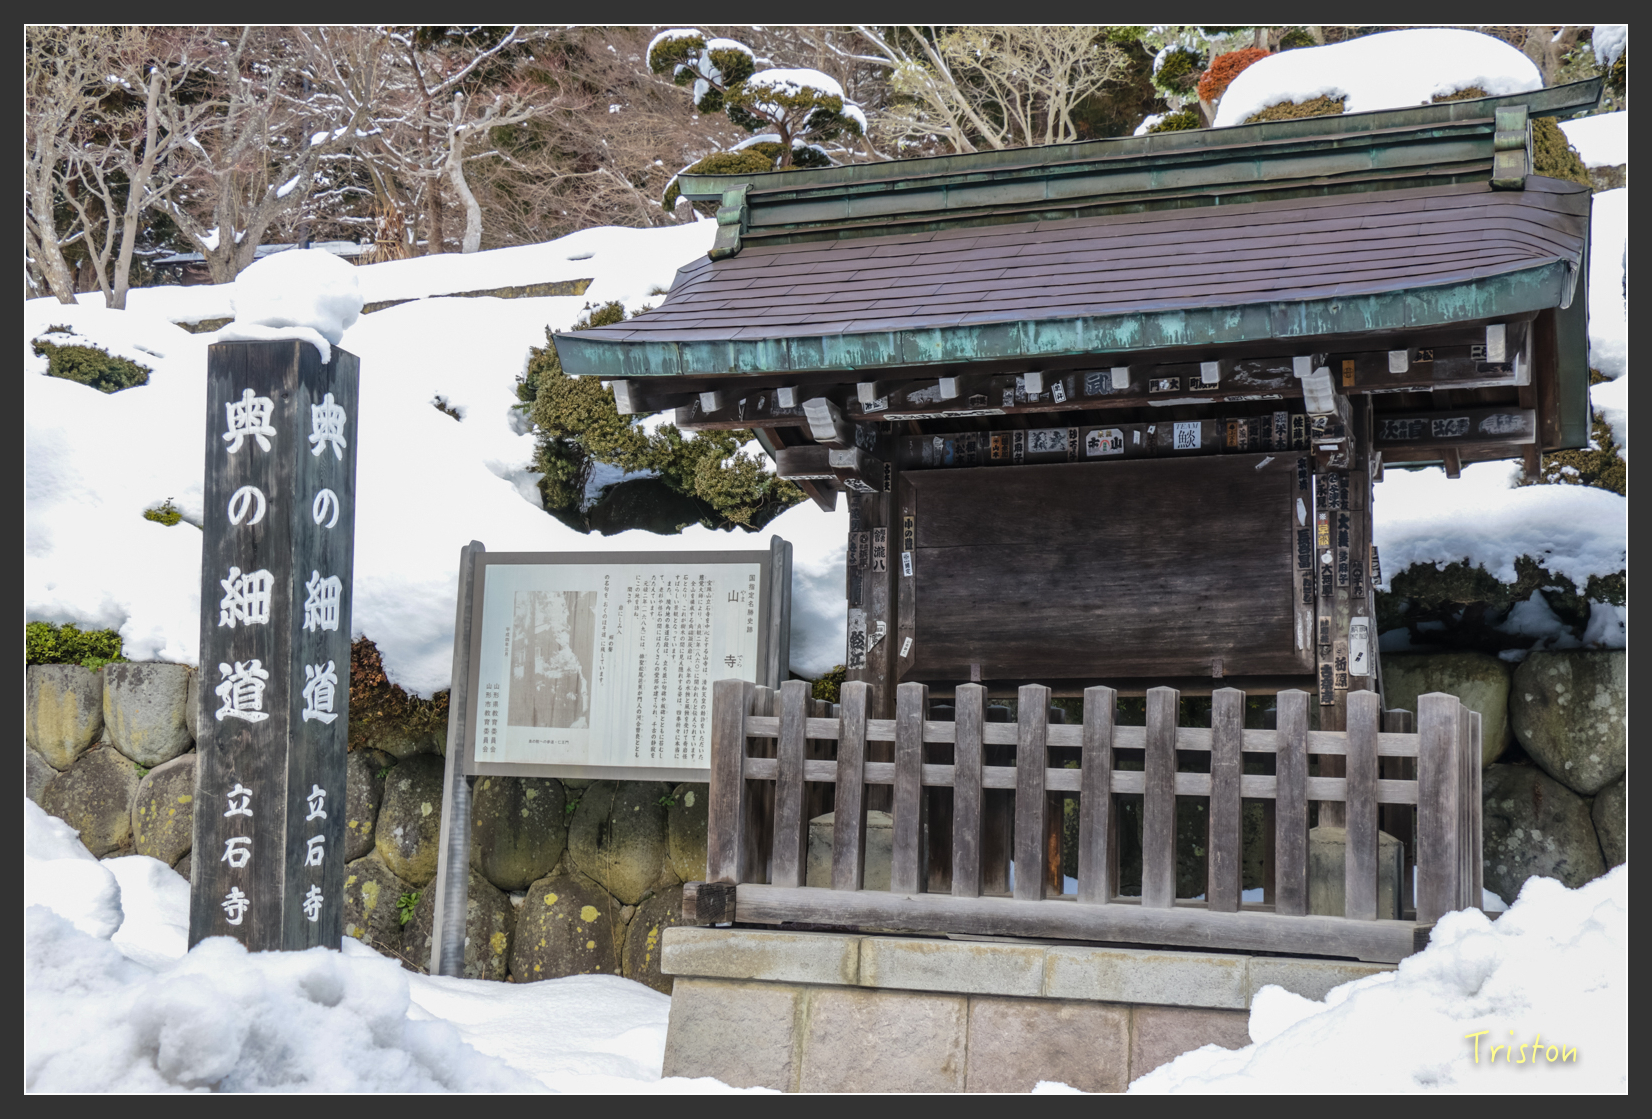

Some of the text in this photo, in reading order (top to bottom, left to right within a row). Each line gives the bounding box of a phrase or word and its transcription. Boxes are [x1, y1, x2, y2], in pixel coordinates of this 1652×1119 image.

[746, 574, 756, 633] 国指定名勝史跡
[482, 683, 493, 753] 山形市教育委員会
[490, 683, 500, 753] 山形県教育委員会
[220, 784, 254, 926] 立石寺
[302, 784, 328, 922] 立石寺
